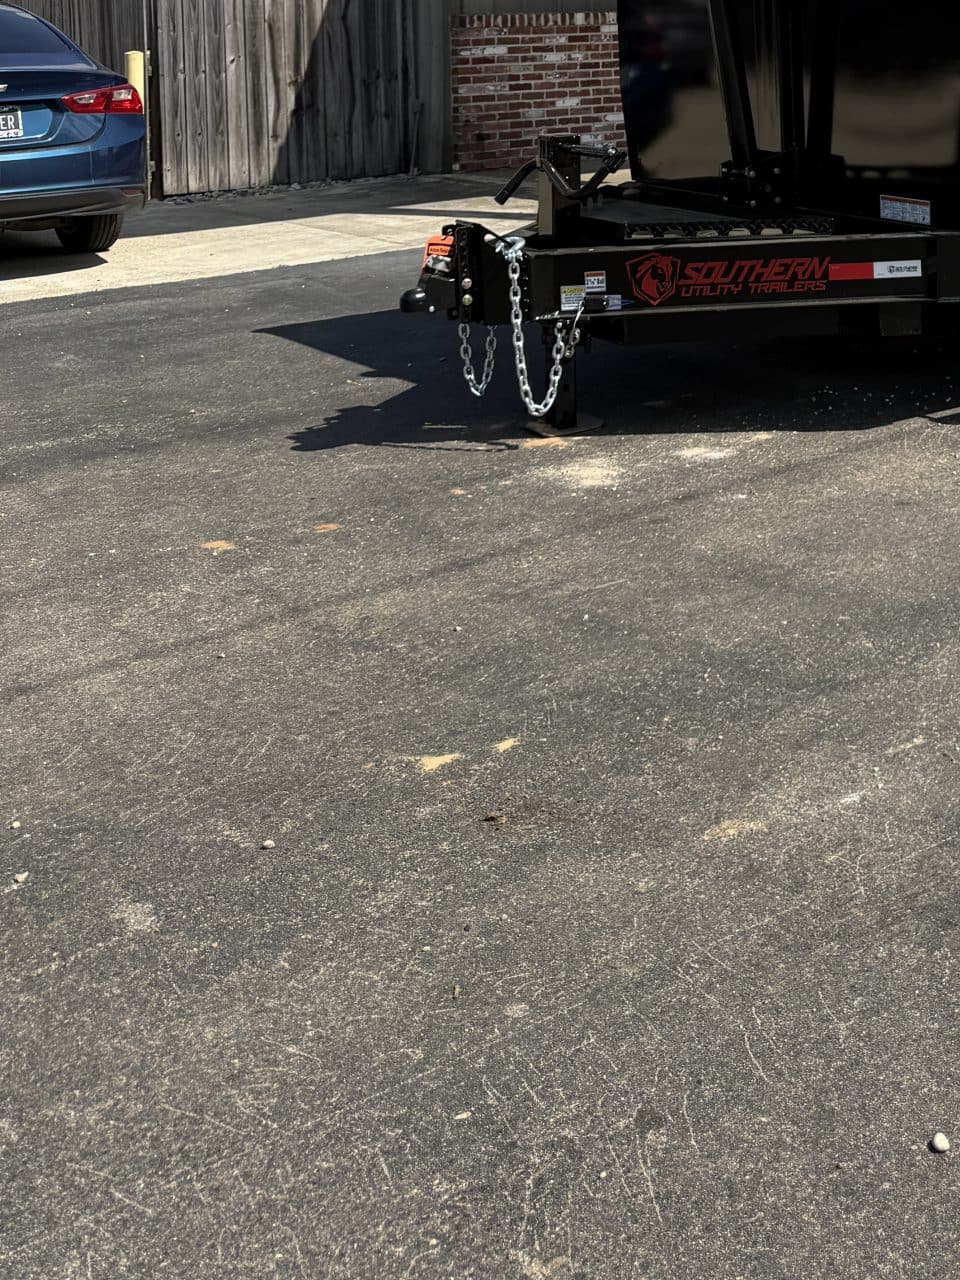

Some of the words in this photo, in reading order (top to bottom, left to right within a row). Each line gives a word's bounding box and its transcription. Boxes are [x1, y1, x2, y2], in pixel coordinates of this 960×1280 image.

[678, 256, 831, 285] SOUTHERN
[681, 283, 743, 297] UTILITY
[749, 280, 828, 294] TRAILERS
